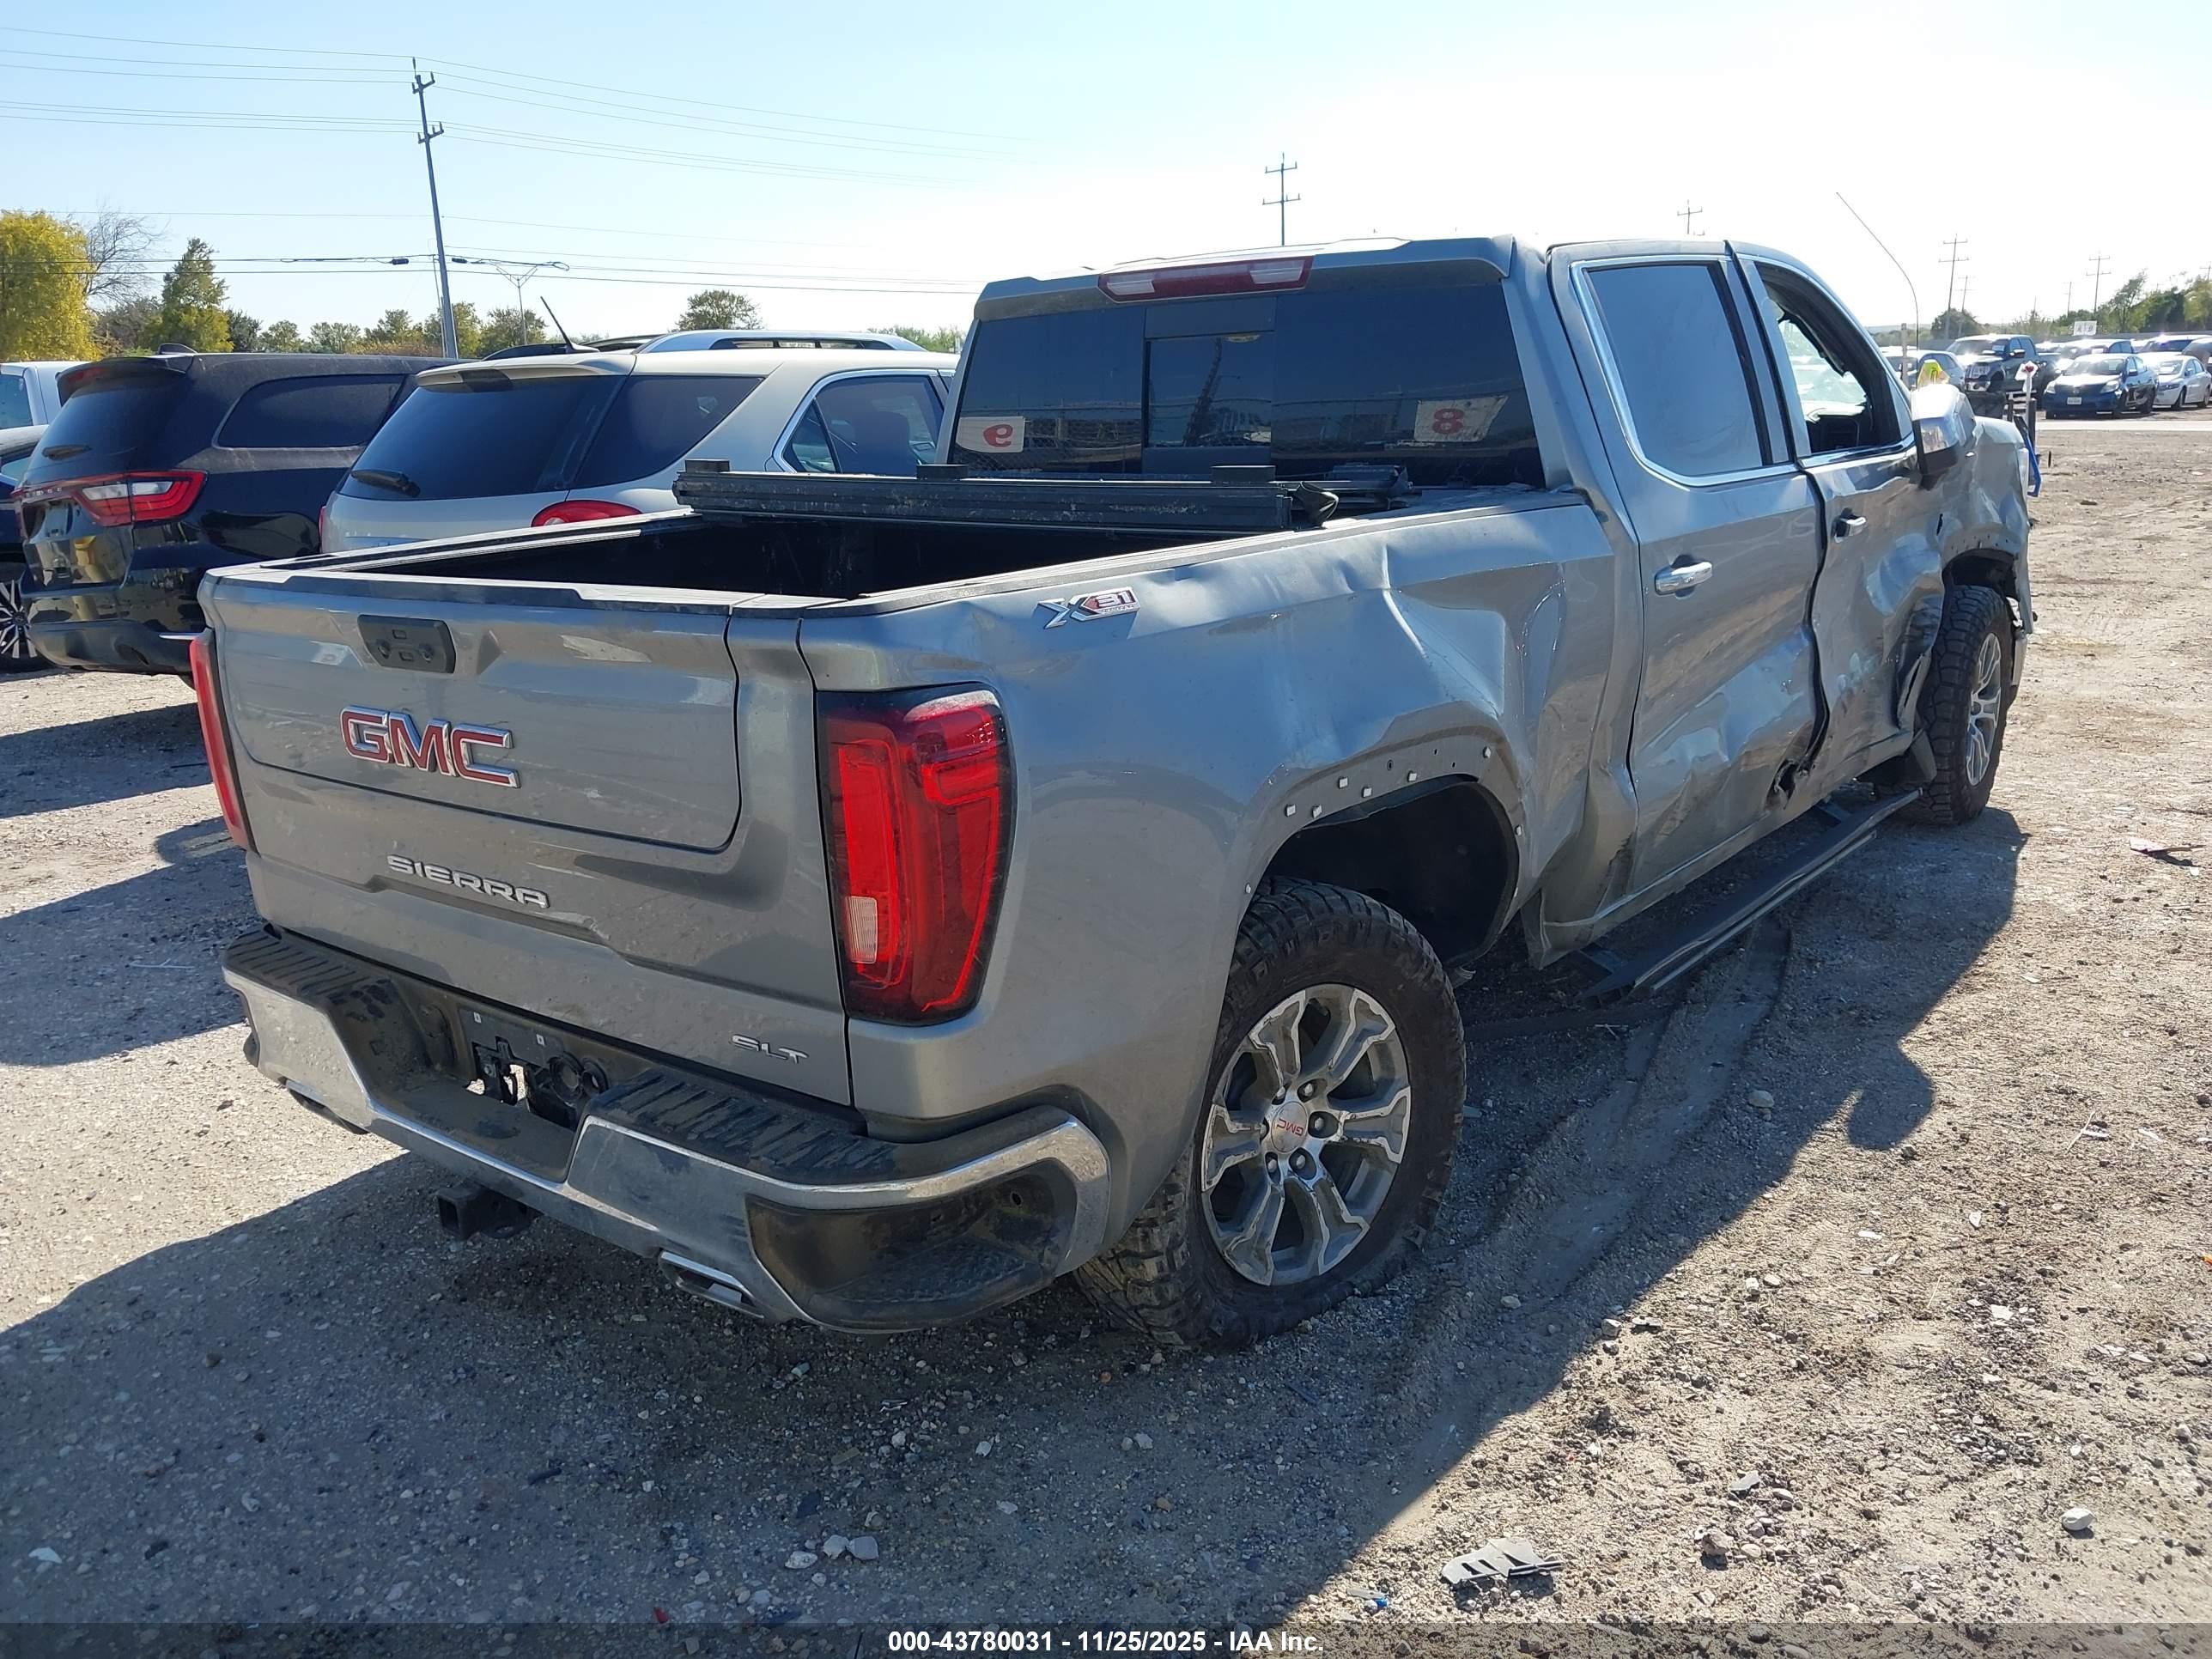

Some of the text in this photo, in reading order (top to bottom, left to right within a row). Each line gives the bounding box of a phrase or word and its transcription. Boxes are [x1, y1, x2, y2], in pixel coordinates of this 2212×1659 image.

[340, 704, 521, 788] GMC
[386, 854, 550, 908] SIERRA
[732, 1034, 809, 1064] SLT
[1276, 1117, 1305, 1137] GMC
